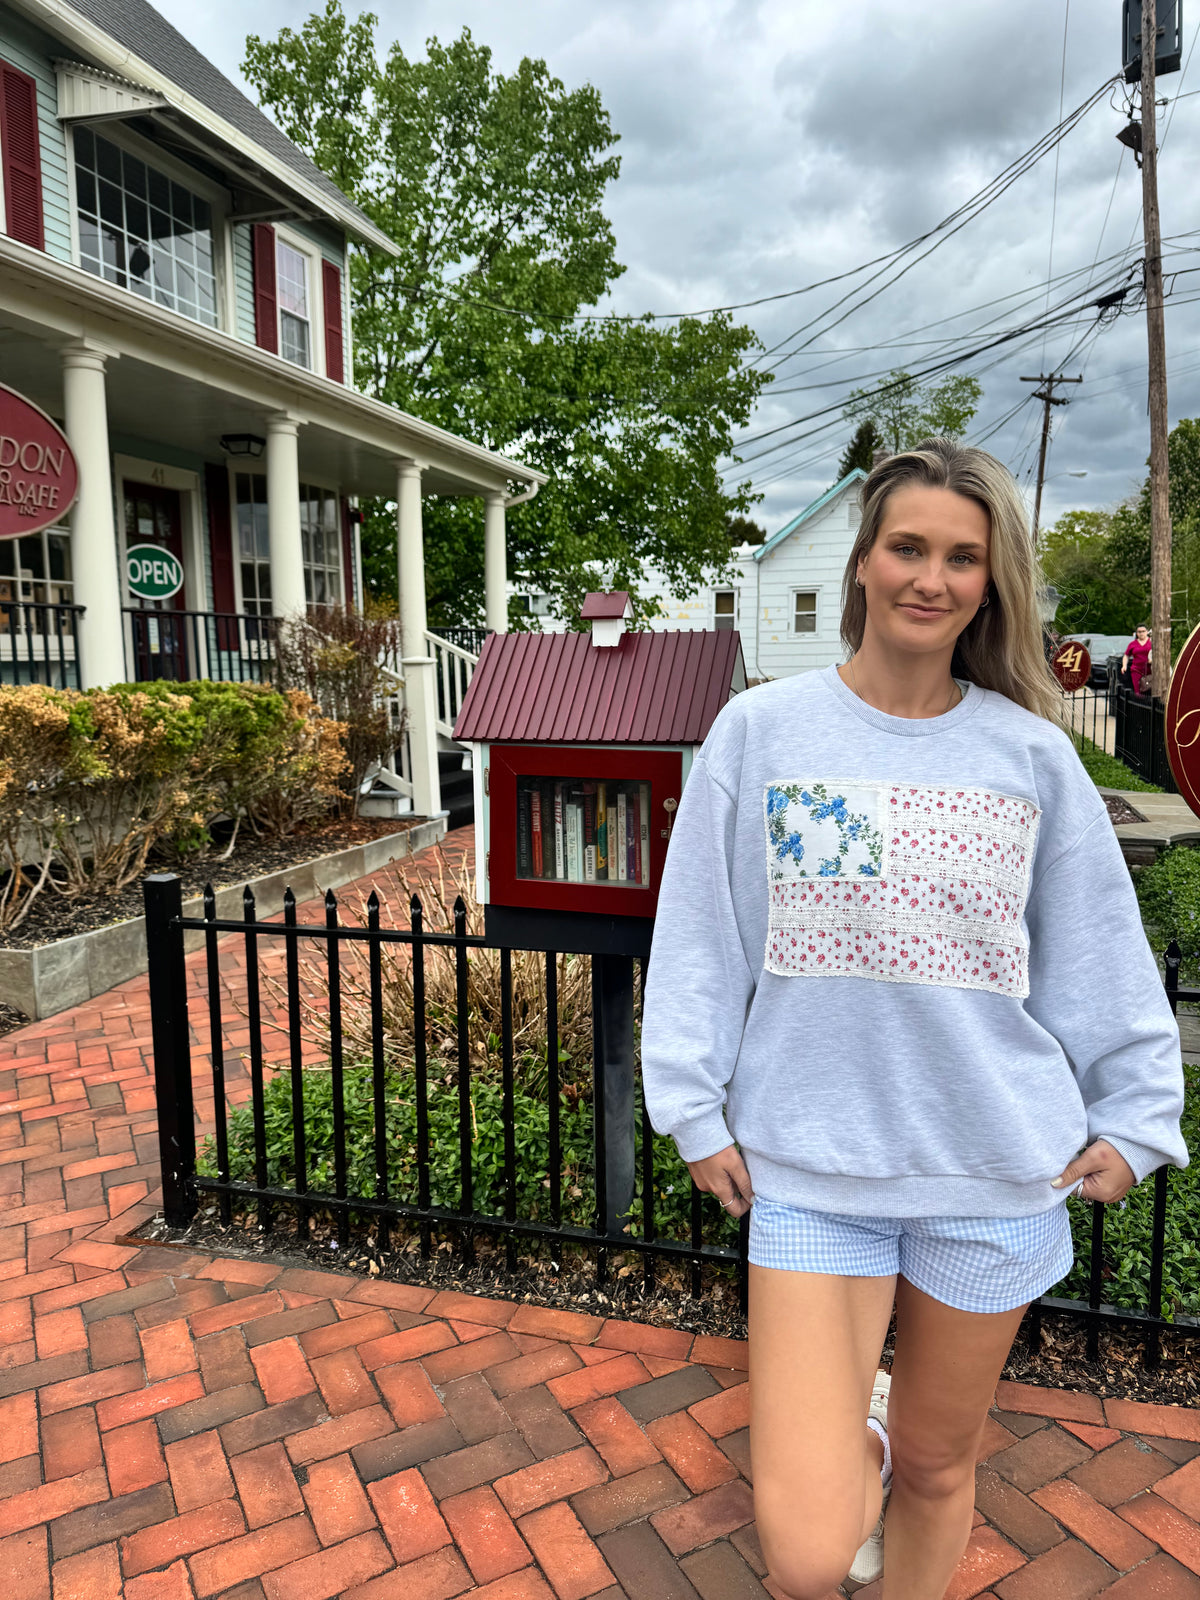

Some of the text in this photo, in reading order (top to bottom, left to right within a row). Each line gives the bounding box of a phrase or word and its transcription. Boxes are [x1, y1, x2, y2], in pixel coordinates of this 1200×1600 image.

[151, 467, 165, 484] 41
[13, 480, 60, 509] SAFE
[127, 558, 178, 586] OPEN
[1056, 645, 1083, 672] 41
[554, 801, 562, 825] BLITZ
